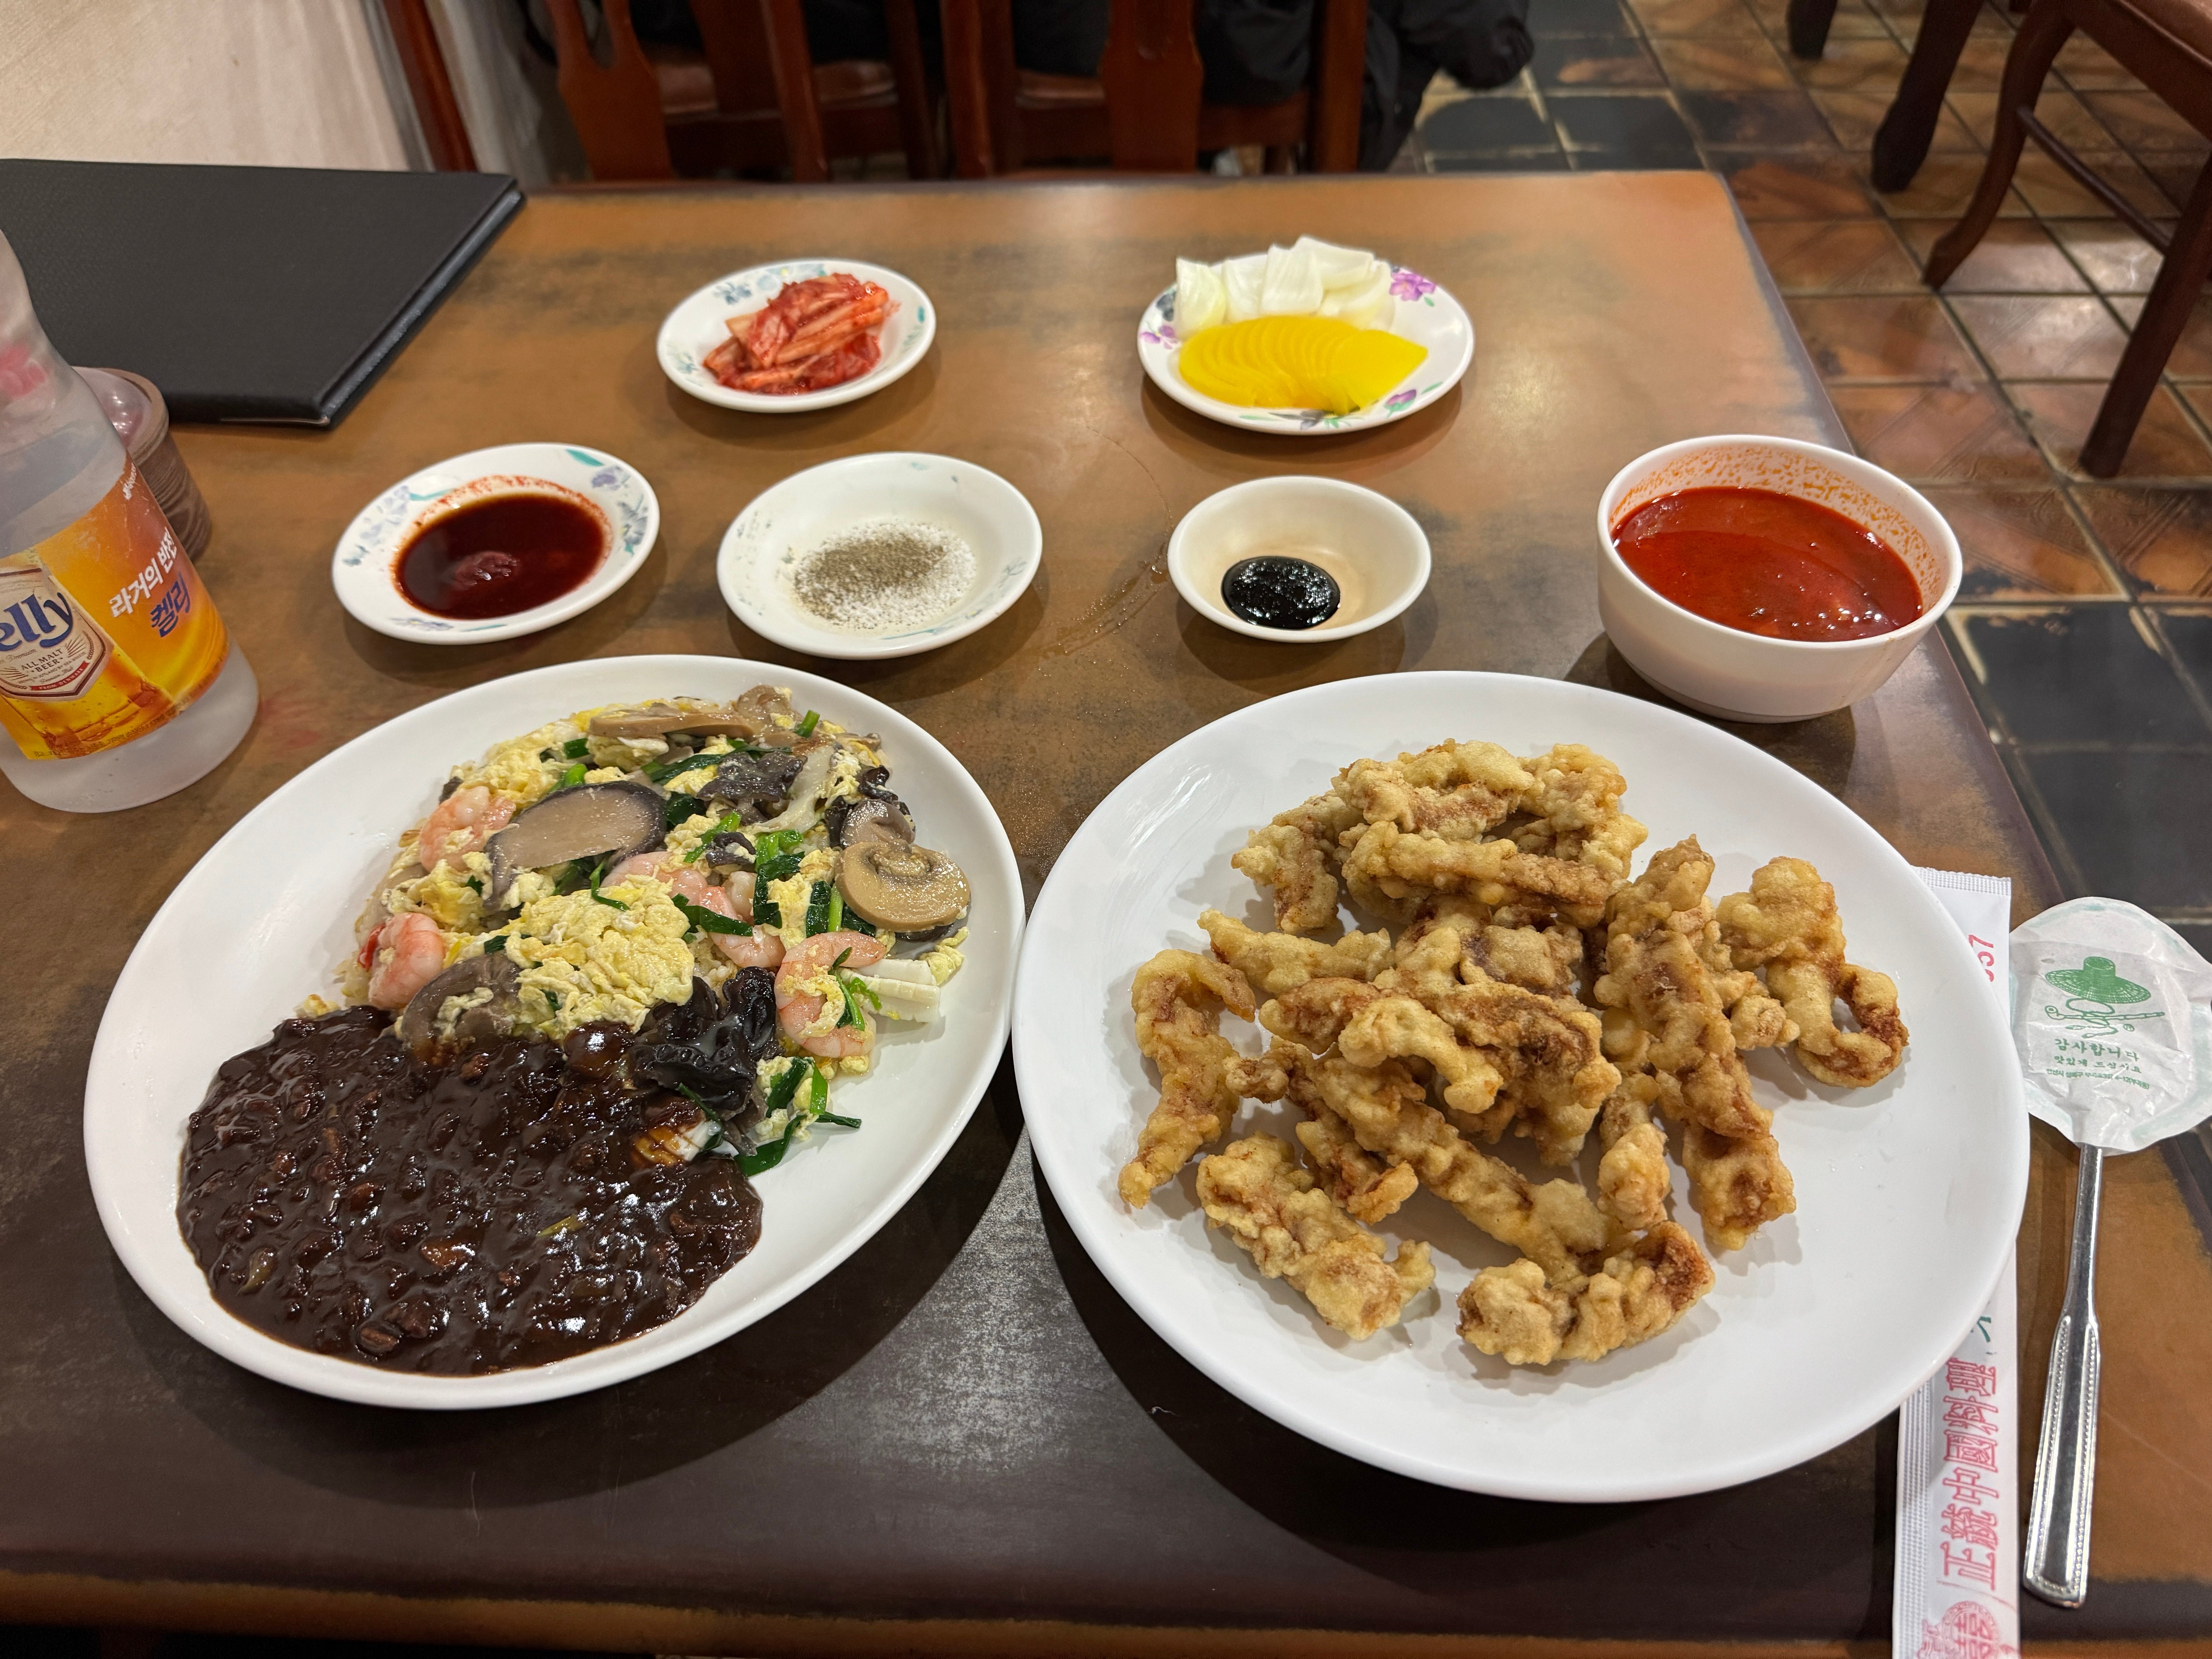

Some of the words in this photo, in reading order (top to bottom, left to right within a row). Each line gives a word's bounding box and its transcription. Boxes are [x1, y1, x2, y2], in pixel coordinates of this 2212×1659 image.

[109, 557, 164, 618] 라거의
[157, 526, 177, 574] 반전
[150, 571, 191, 638] 켈리
[21, 661, 39, 670] ALL
[38, 648, 63, 663] MALT
[2054, 1038, 2140, 1061] 감사합니다
